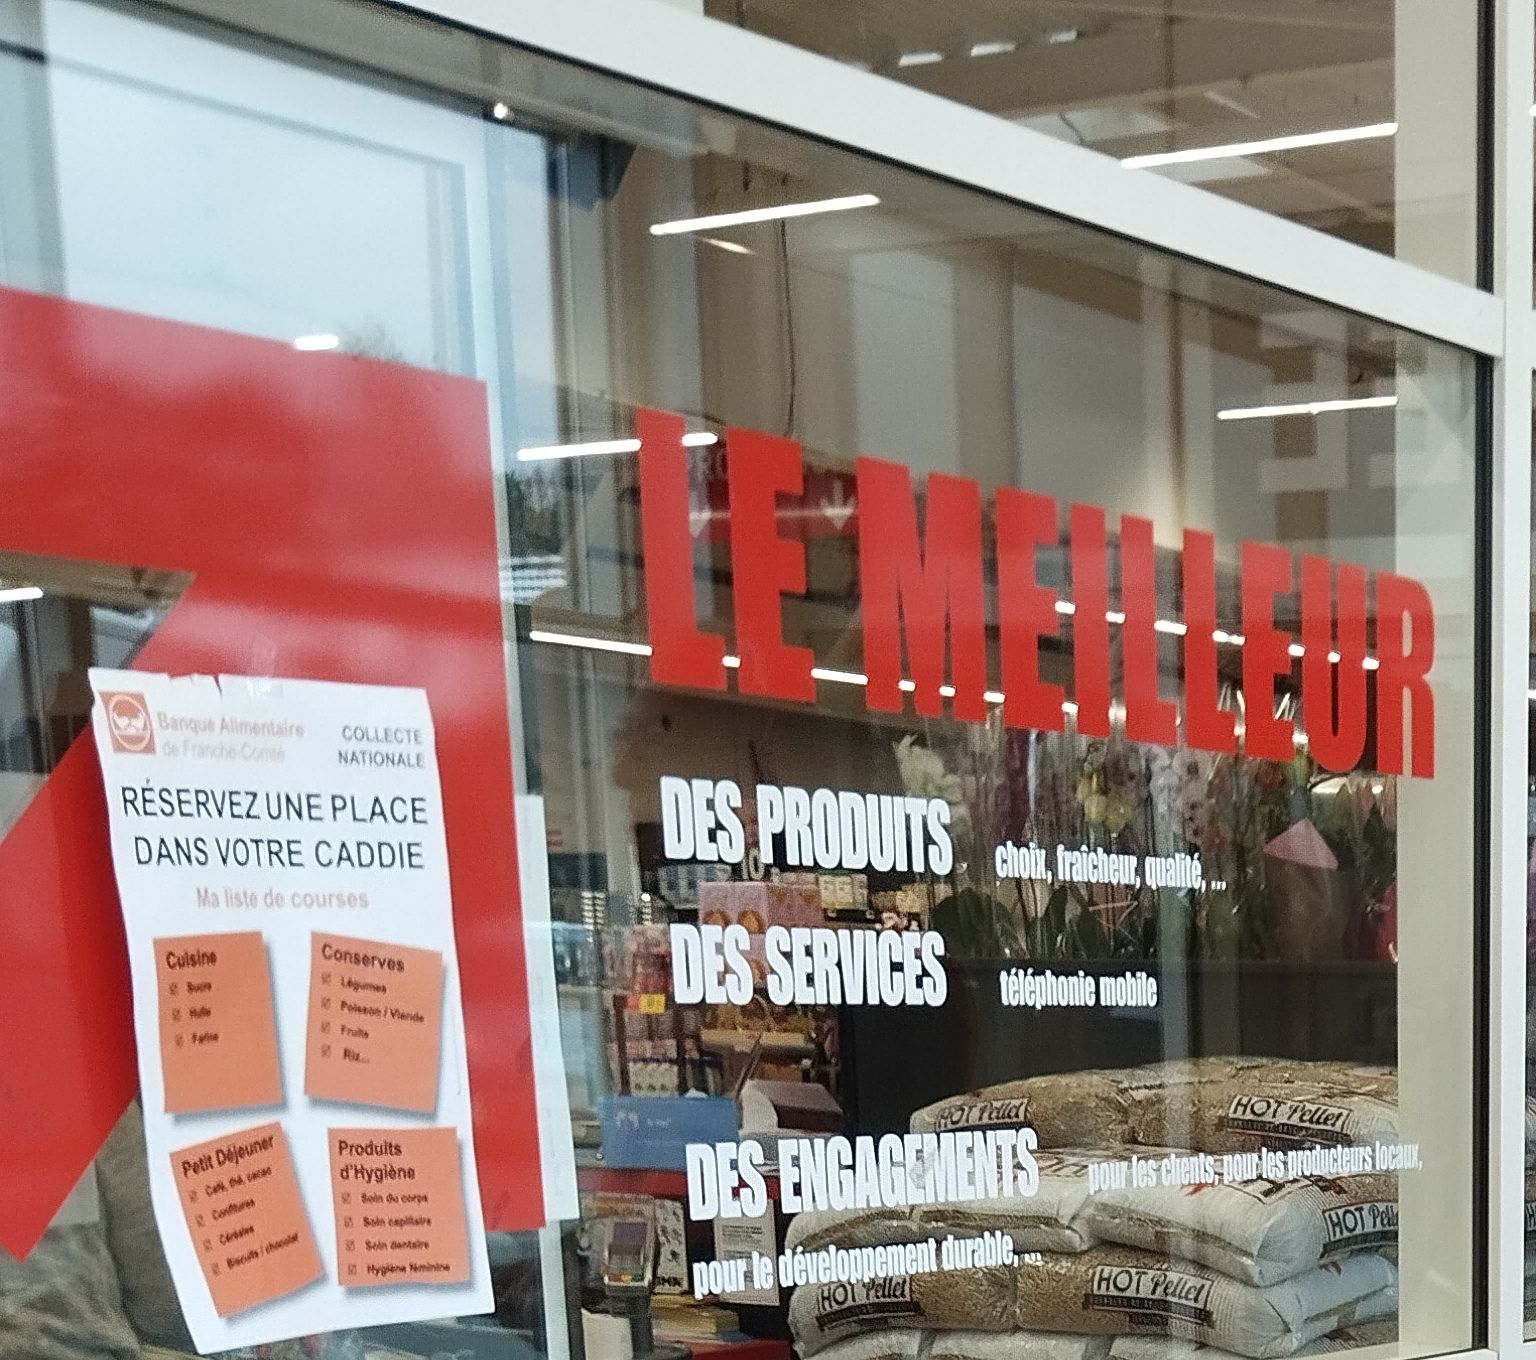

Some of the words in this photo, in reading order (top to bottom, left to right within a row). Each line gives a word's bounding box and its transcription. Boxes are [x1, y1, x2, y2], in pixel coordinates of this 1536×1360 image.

[634, 407, 817, 703] LE
[854, 454, 1437, 780] MEILLEUR
[157, 711, 215, 737] Banque
[219, 716, 305, 738] Alimentaire
[342, 725, 424, 745] COLLECTE
[338, 751, 426, 768] NATIONALE
[121, 778, 260, 820] RÉSERVEZ
[265, 793, 323, 821] UNE
[331, 794, 428, 824] PLACE
[660, 776, 745, 865] DES
[755, 784, 953, 876] PRODUITS
[134, 836, 209, 866] DANS
[215, 838, 305, 867] VOTRE
[314, 840, 424, 870] CADDIE
[996, 840, 1053, 886] choix,
[1056, 844, 1141, 888] fraîcheur,
[1145, 844, 1207, 891] qualité,
[196, 888, 220, 909] Ma
[223, 887, 258, 909] liste
[263, 888, 284, 909] de
[291, 892, 370, 910] courses
[166, 949, 218, 970] Cuisine
[321, 942, 405, 973] Conserves
[669, 924, 753, 1006] DES
[765, 926, 948, 1008] SERVICES
[999, 967, 1097, 1011] téléphonie
[1099, 968, 1158, 1009] mobile
[1232, 1095, 1284, 1122] HOT
[1286, 1103, 1344, 1129] Pellet
[181, 1155, 214, 1179] Petit
[216, 1135, 275, 1168] Déjeuner
[338, 1139, 403, 1157] Produits
[340, 1163, 416, 1185] d'Hygiène
[685, 1139, 768, 1222] DES
[777, 1127, 1040, 1215] ENGAGEMENTS
[1088, 1161, 1128, 1194] pour
[1131, 1154, 1157, 1188] les
[1222, 1153, 1259, 1184] pour
[1261, 1147, 1286, 1179] les
[1287, 1143, 1373, 1181] producteurs
[361, 1193, 384, 1205] Soin
[363, 1216, 386, 1228] Soin
[1328, 1208, 1366, 1238] HOT
[365, 1239, 387, 1251] Soin
[693, 1259, 747, 1301] pour
[752, 1251, 775, 1288] le
[778, 1236, 939, 1289] développement
[942, 1230, 1020, 1272] durable,
[820, 1281, 860, 1311] HOT
[862, 1276, 910, 1301] Pellet
[1098, 1268, 1151, 1296] HOT
[1151, 1270, 1203, 1303] Pellet
